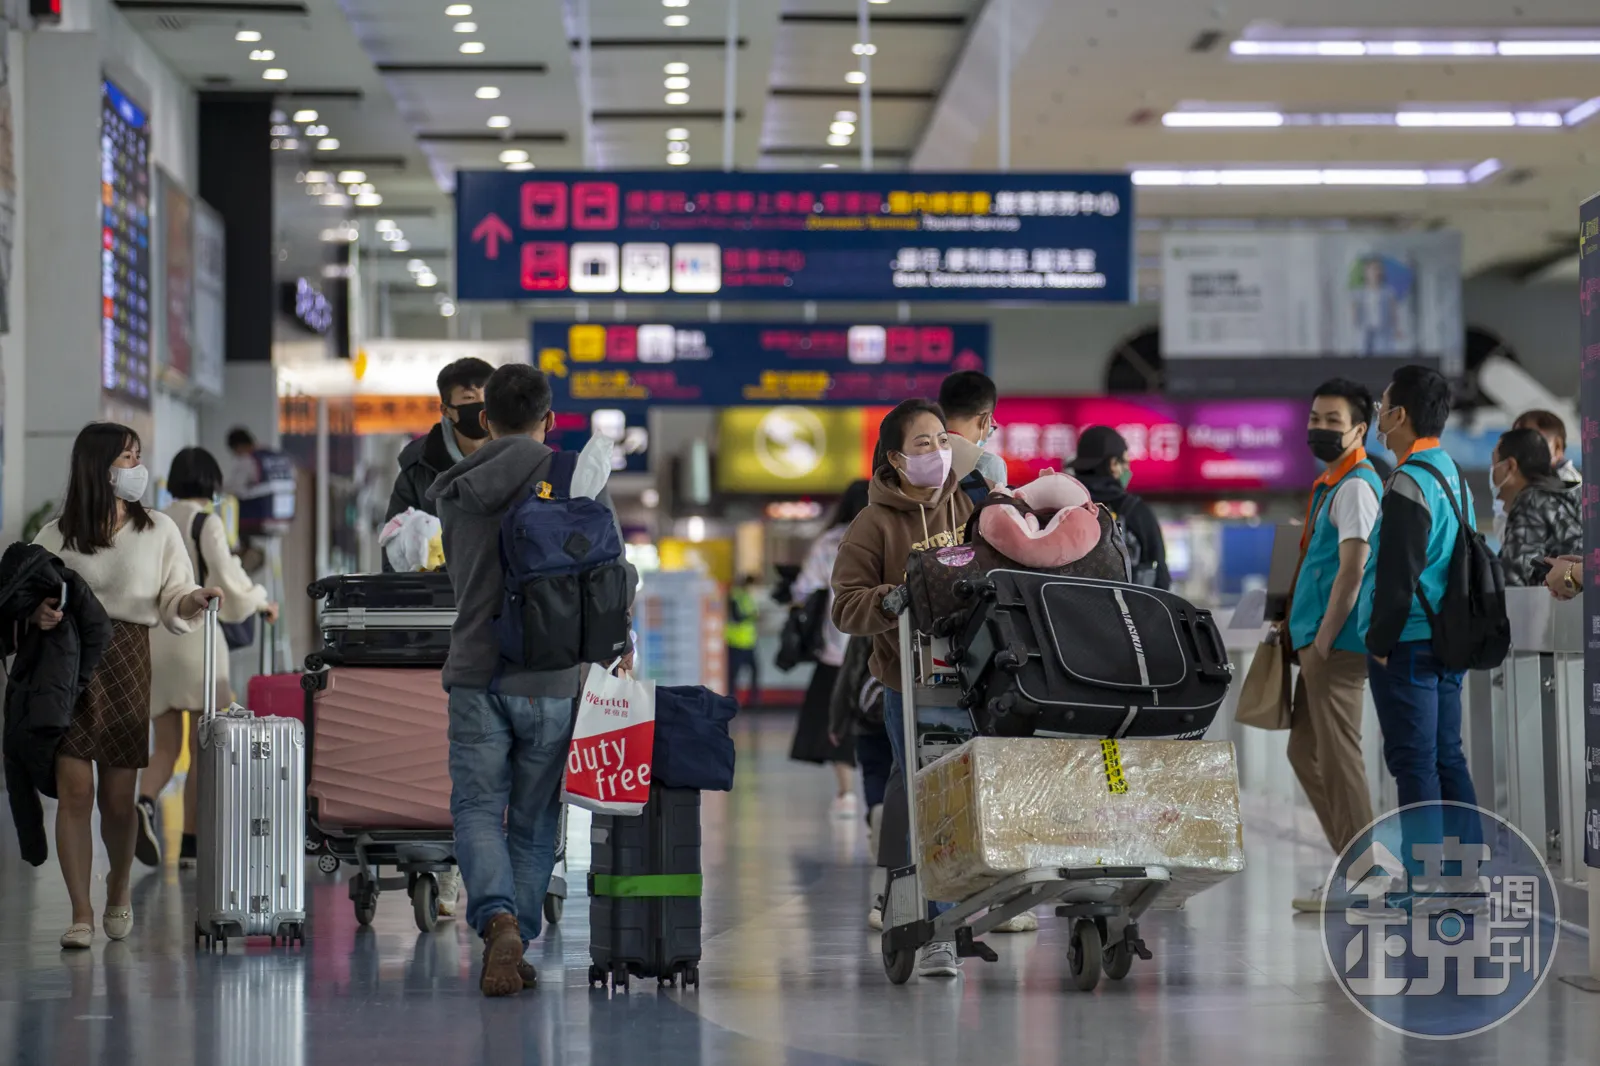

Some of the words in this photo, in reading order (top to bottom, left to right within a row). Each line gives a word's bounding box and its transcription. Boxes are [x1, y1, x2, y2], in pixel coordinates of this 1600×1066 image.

[586, 690, 628, 708] everrich
[568, 737, 626, 774] duty
[595, 763, 651, 801] free
